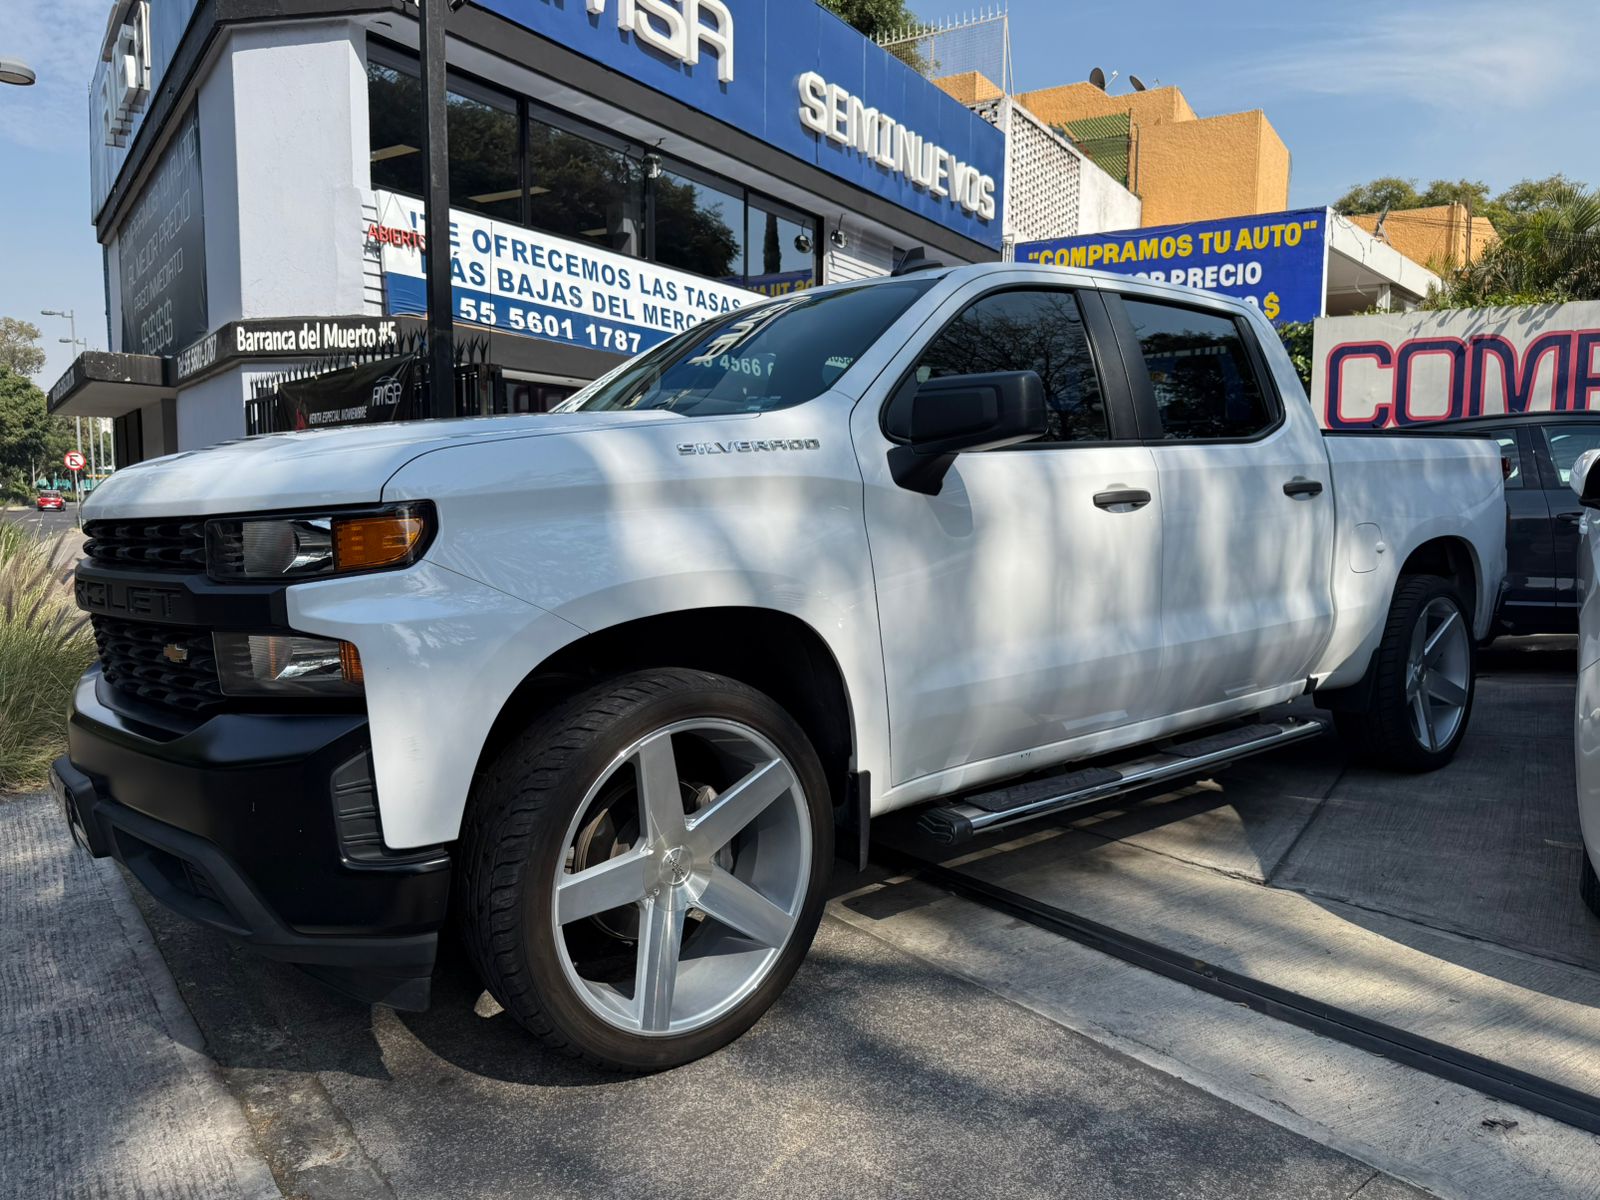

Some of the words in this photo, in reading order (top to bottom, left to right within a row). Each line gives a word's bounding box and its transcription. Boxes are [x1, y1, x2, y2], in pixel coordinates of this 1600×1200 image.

[797, 70, 995, 221] SEMINUEVOS
[1199, 230, 1232, 255] TU
[472, 229, 631, 290] OFRECEMOS
[639, 273, 678, 302] LAS
[684, 285, 741, 313] TASAS
[1170, 261, 1262, 289] PRECIO
[497, 267, 583, 309] BAJAS
[592, 290, 635, 321] DEL
[643, 302, 707, 332] MERC
[236, 325, 297, 352] Barranca
[299, 322, 320, 350] del
[324, 322, 376, 350] Muerto
[378, 321, 397, 348] #5
[460, 297, 497, 326] 55
[509, 307, 574, 340] 5601
[585, 324, 641, 353] 1787
[677, 438, 820, 456] SILVERADO
